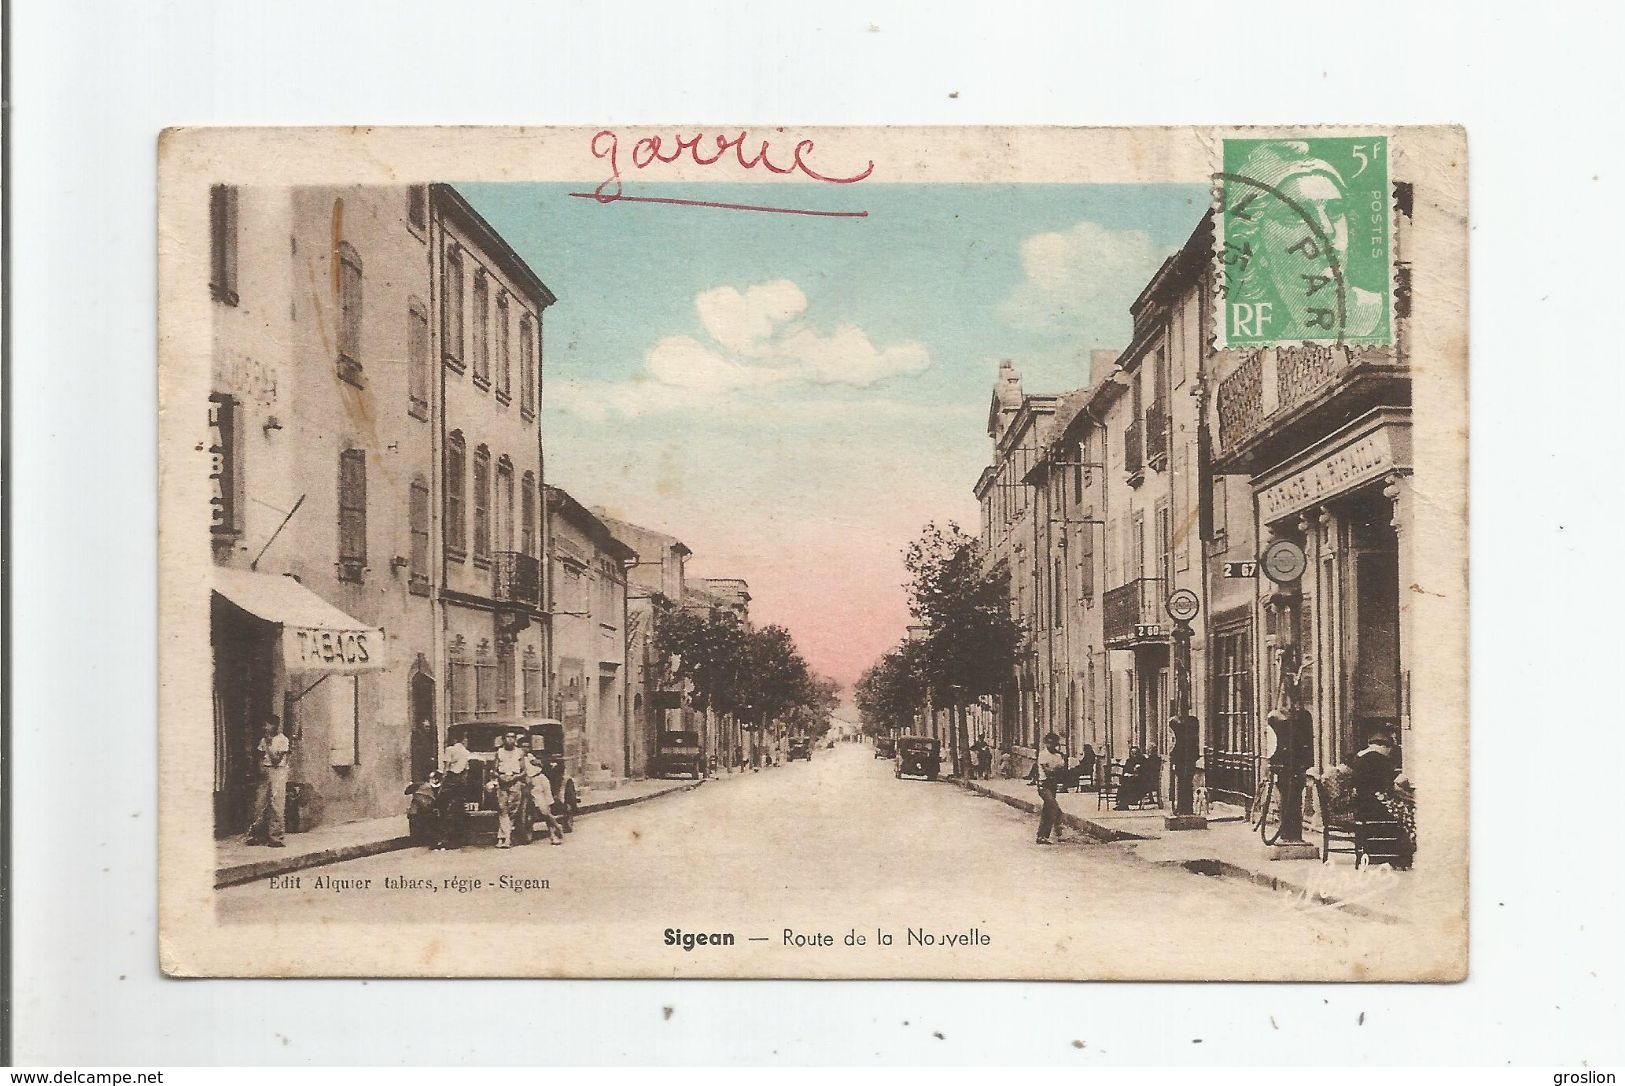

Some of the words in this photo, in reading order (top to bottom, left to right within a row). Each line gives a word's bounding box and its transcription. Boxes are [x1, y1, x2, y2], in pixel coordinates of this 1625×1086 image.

[1371, 190, 1383, 259] POSTES
[1231, 301, 1273, 338] RF
[1241, 563, 1257, 577] 67
[296, 631, 370, 664] TABACS
[313, 875, 372, 893] Alquier
[499, 874, 551, 893] Sigean
[663, 928, 735, 951] Sigean
[783, 929, 834, 947] Route
[844, 929, 867, 946] de
[877, 928, 893, 946] la
